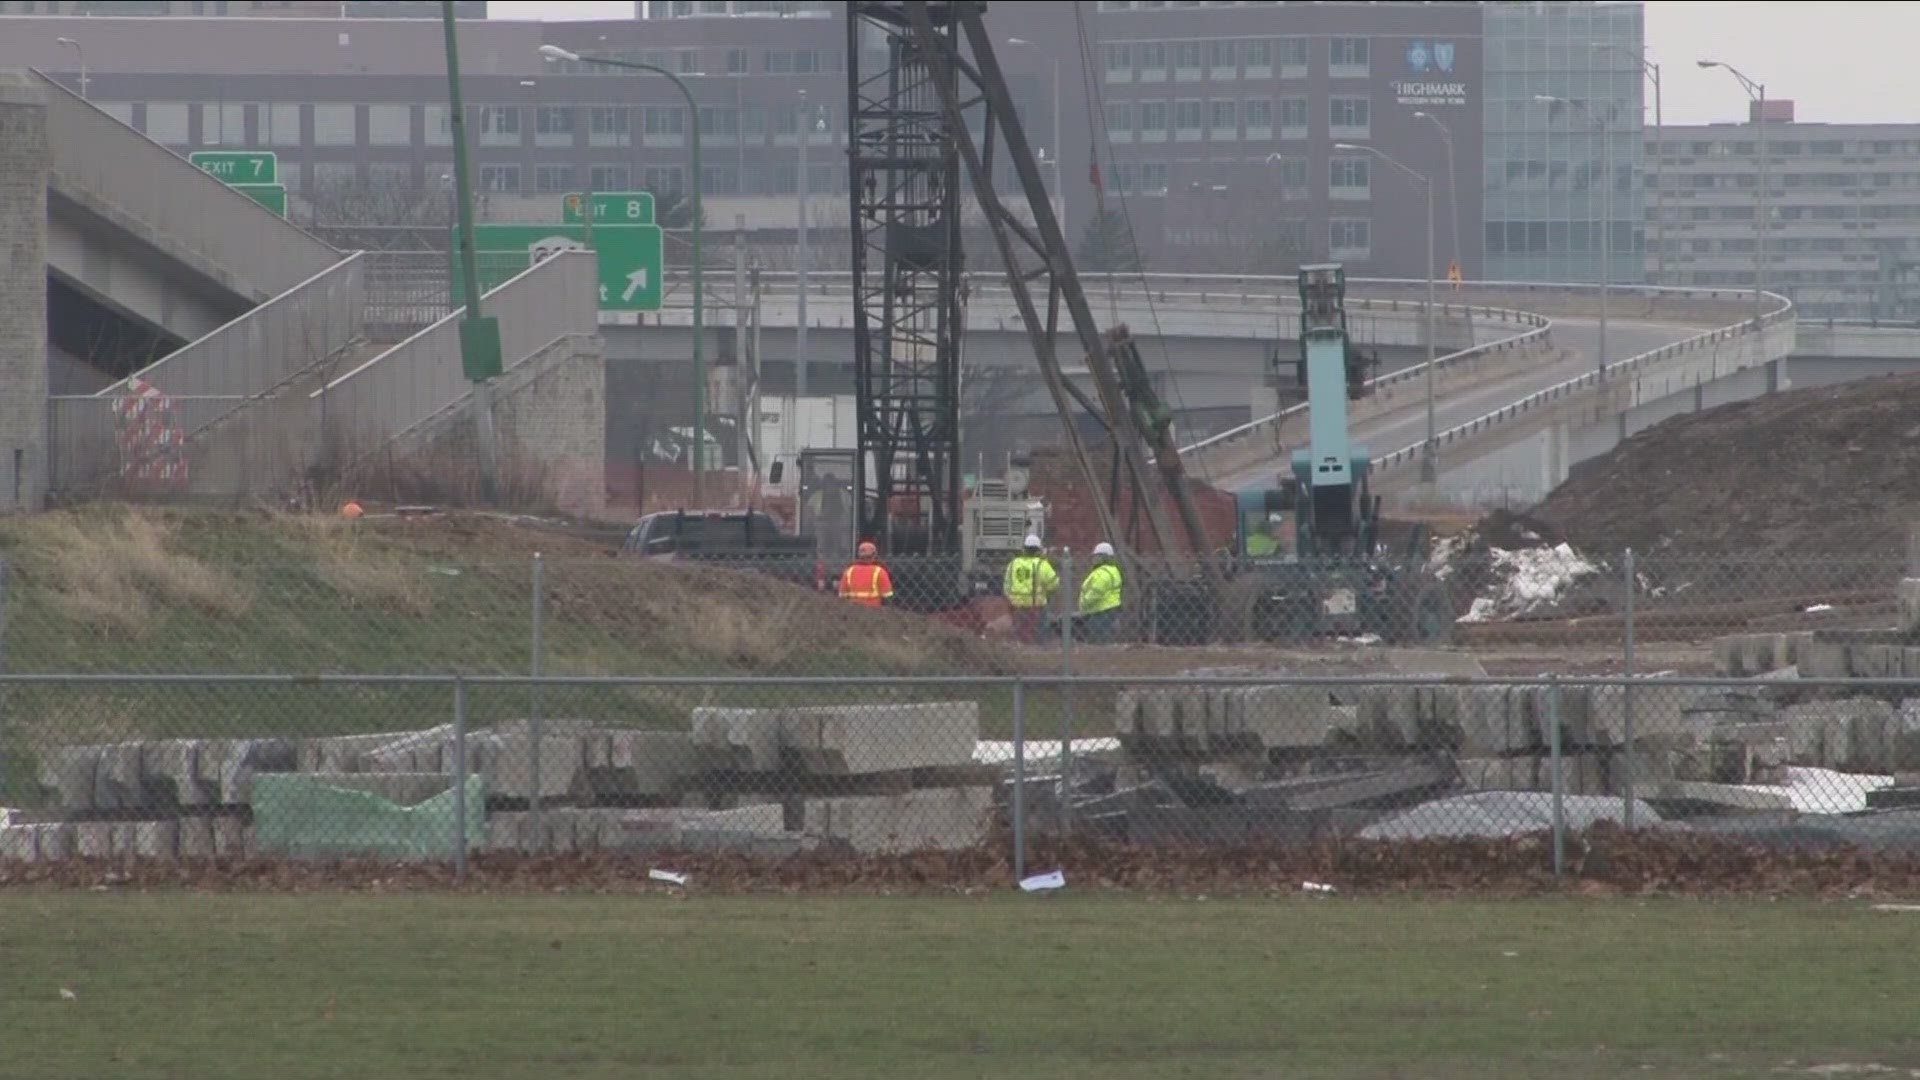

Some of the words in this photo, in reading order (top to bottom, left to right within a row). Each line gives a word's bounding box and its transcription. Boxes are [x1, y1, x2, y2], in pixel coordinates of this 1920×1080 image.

[1397, 83, 1466, 95] HIGHMARK
[201, 161, 235, 174] EXIT
[250, 159, 264, 176] 7
[575, 204, 607, 217] EIT
[626, 200, 641, 218] 8
